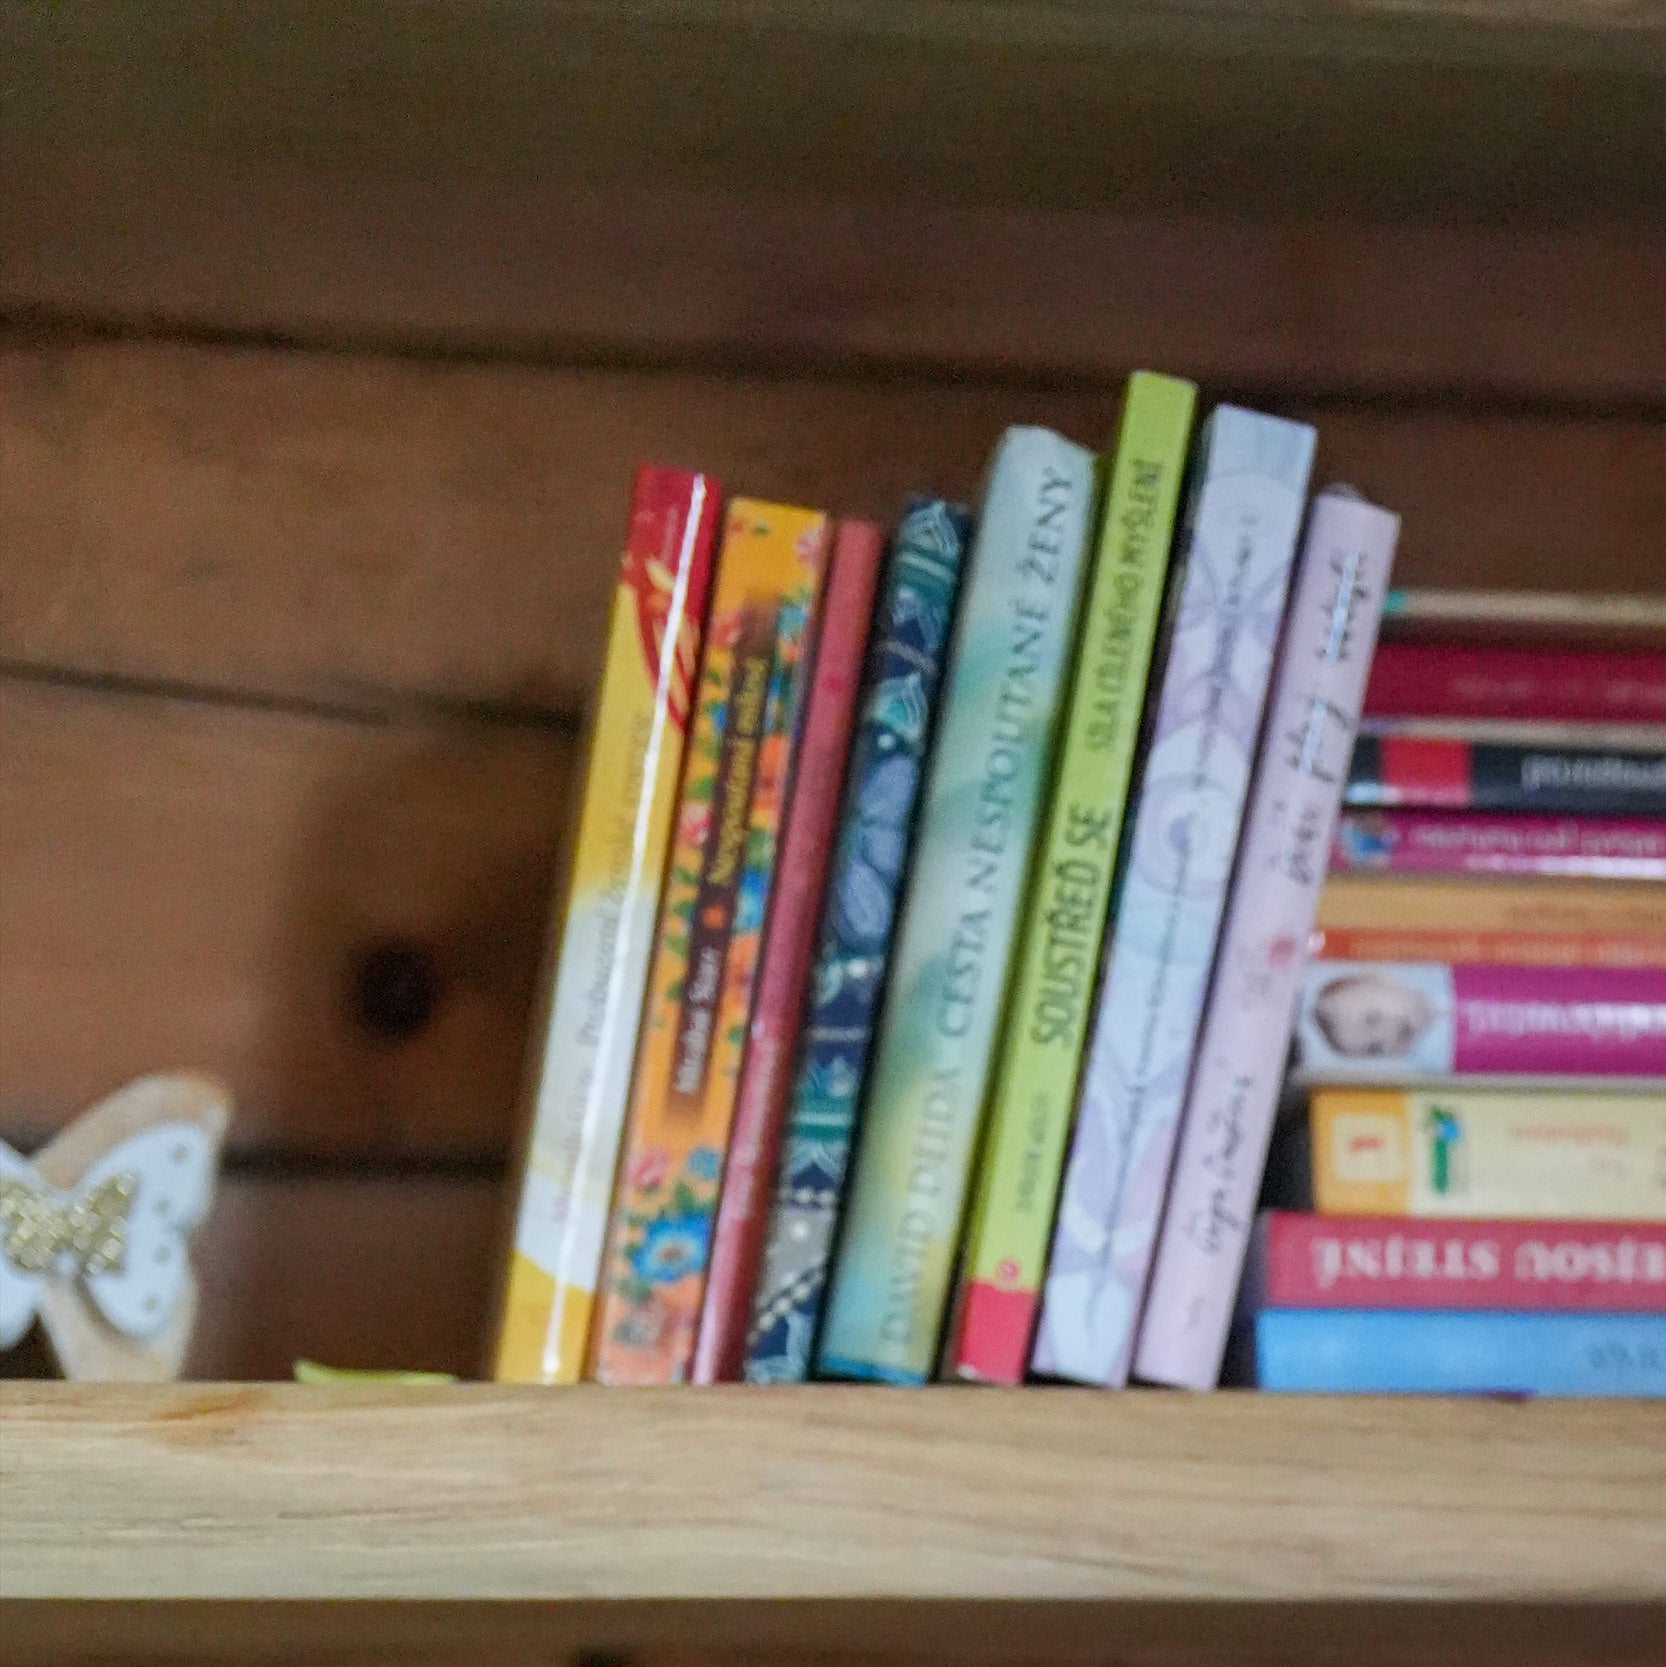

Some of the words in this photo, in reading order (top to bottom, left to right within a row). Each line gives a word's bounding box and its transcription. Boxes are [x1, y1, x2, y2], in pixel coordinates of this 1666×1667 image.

[937, 908, 992, 1038] CESTA
[968, 598, 1050, 894] NESPOUTANÉ
[1014, 466, 1074, 586] ŽENY
[1064, 802, 1111, 848] SE
[1030, 856, 1099, 1053] SOUSTŘEĎ
[1310, 1234, 1500, 1290] STEJNÉ
